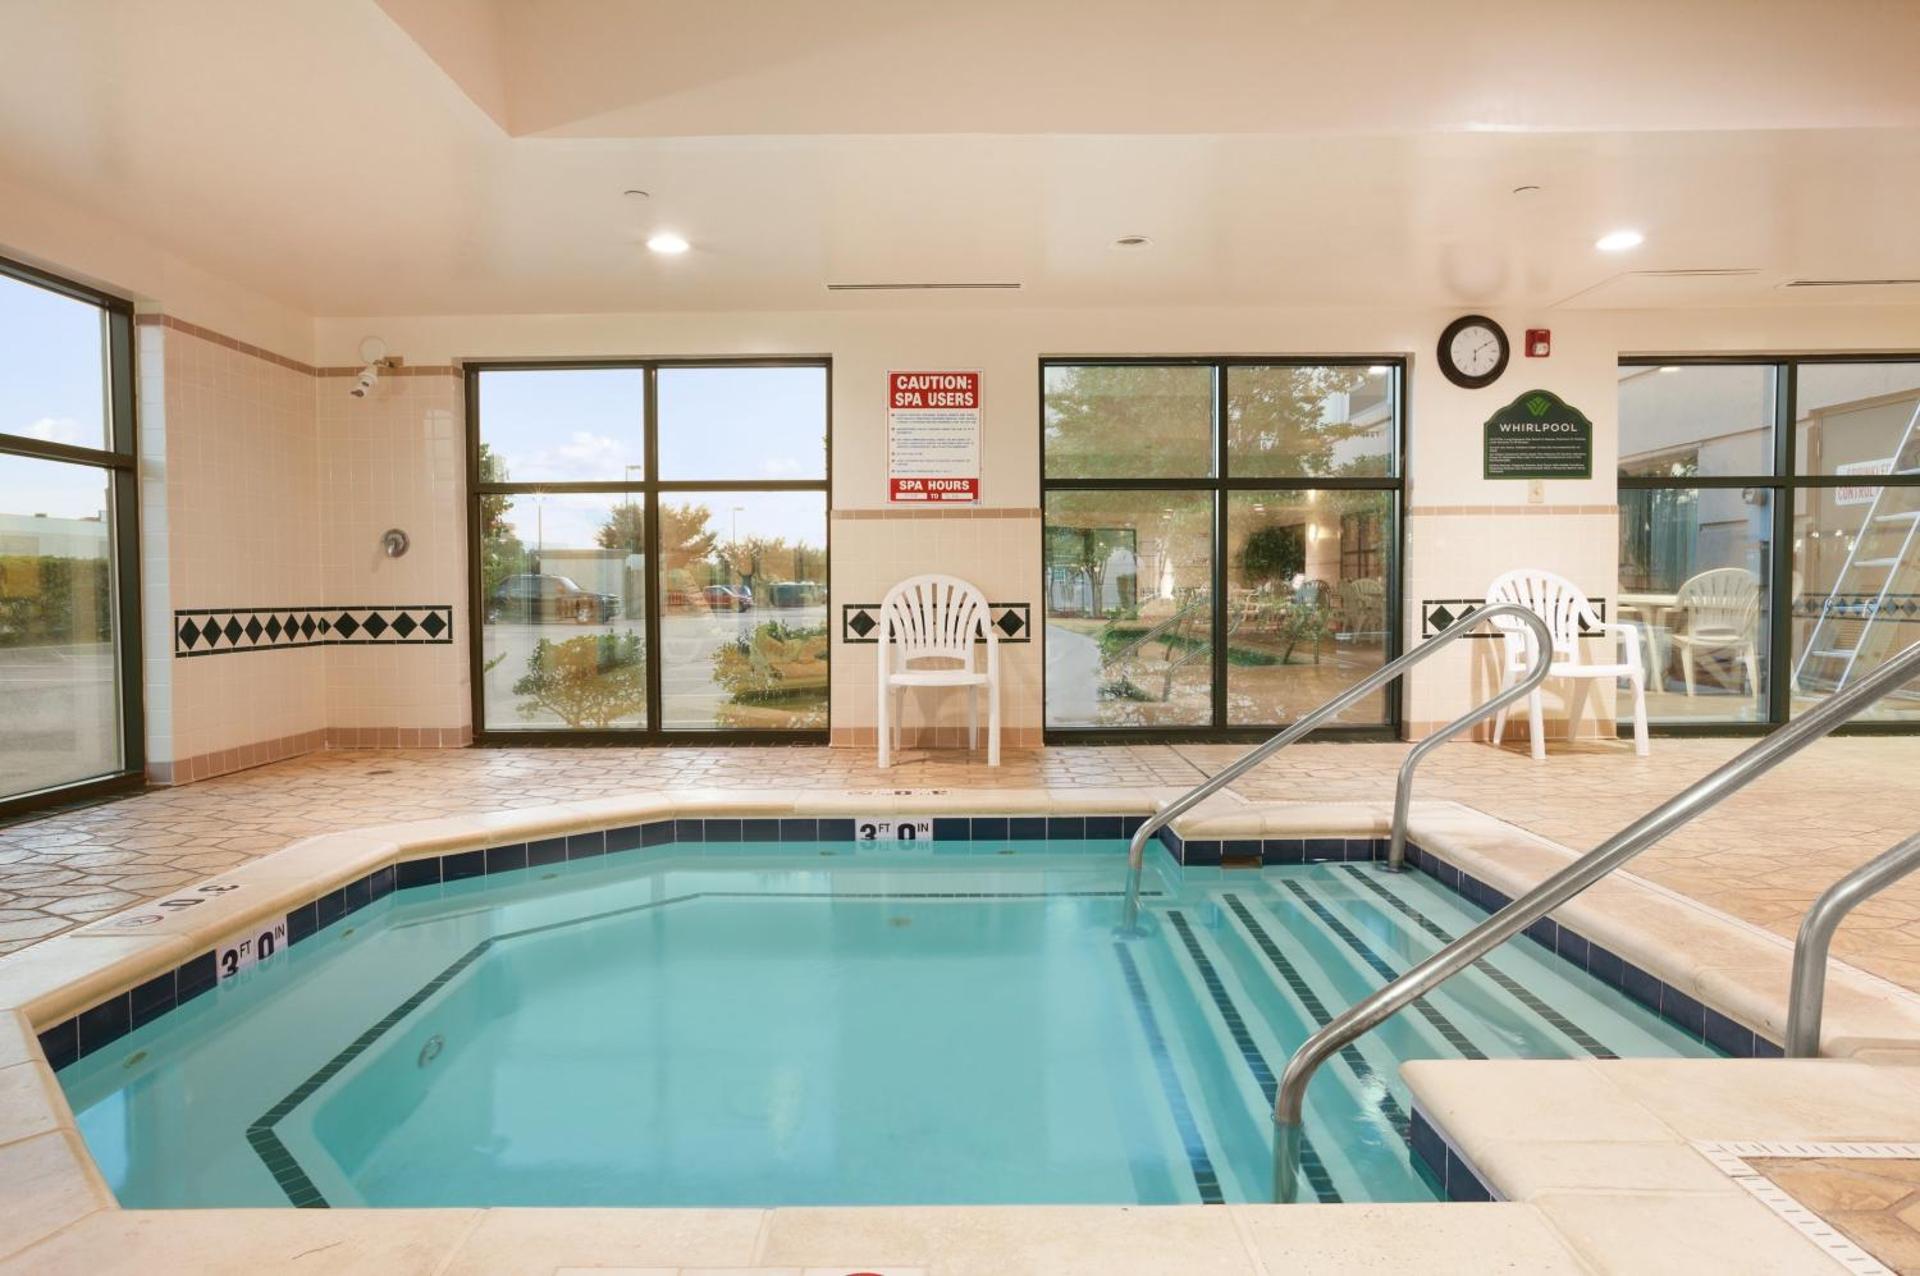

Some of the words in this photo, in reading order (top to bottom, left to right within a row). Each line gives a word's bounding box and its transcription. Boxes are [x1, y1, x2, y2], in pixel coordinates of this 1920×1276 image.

[896, 376, 972, 389] CAUTION:
[895, 392, 922, 406] SPA
[928, 392, 974, 406] USERS
[1500, 423, 1577, 432] WHIRLPOOL
[899, 480, 923, 490] SPA
[928, 480, 970, 490] HOURS
[860, 823, 877, 840] 3
[878, 823, 890, 832] FT
[917, 823, 929, 832] IN
[221, 948, 239, 978] 3
[239, 940, 252, 959] FT
[274, 924, 286, 939] IN
